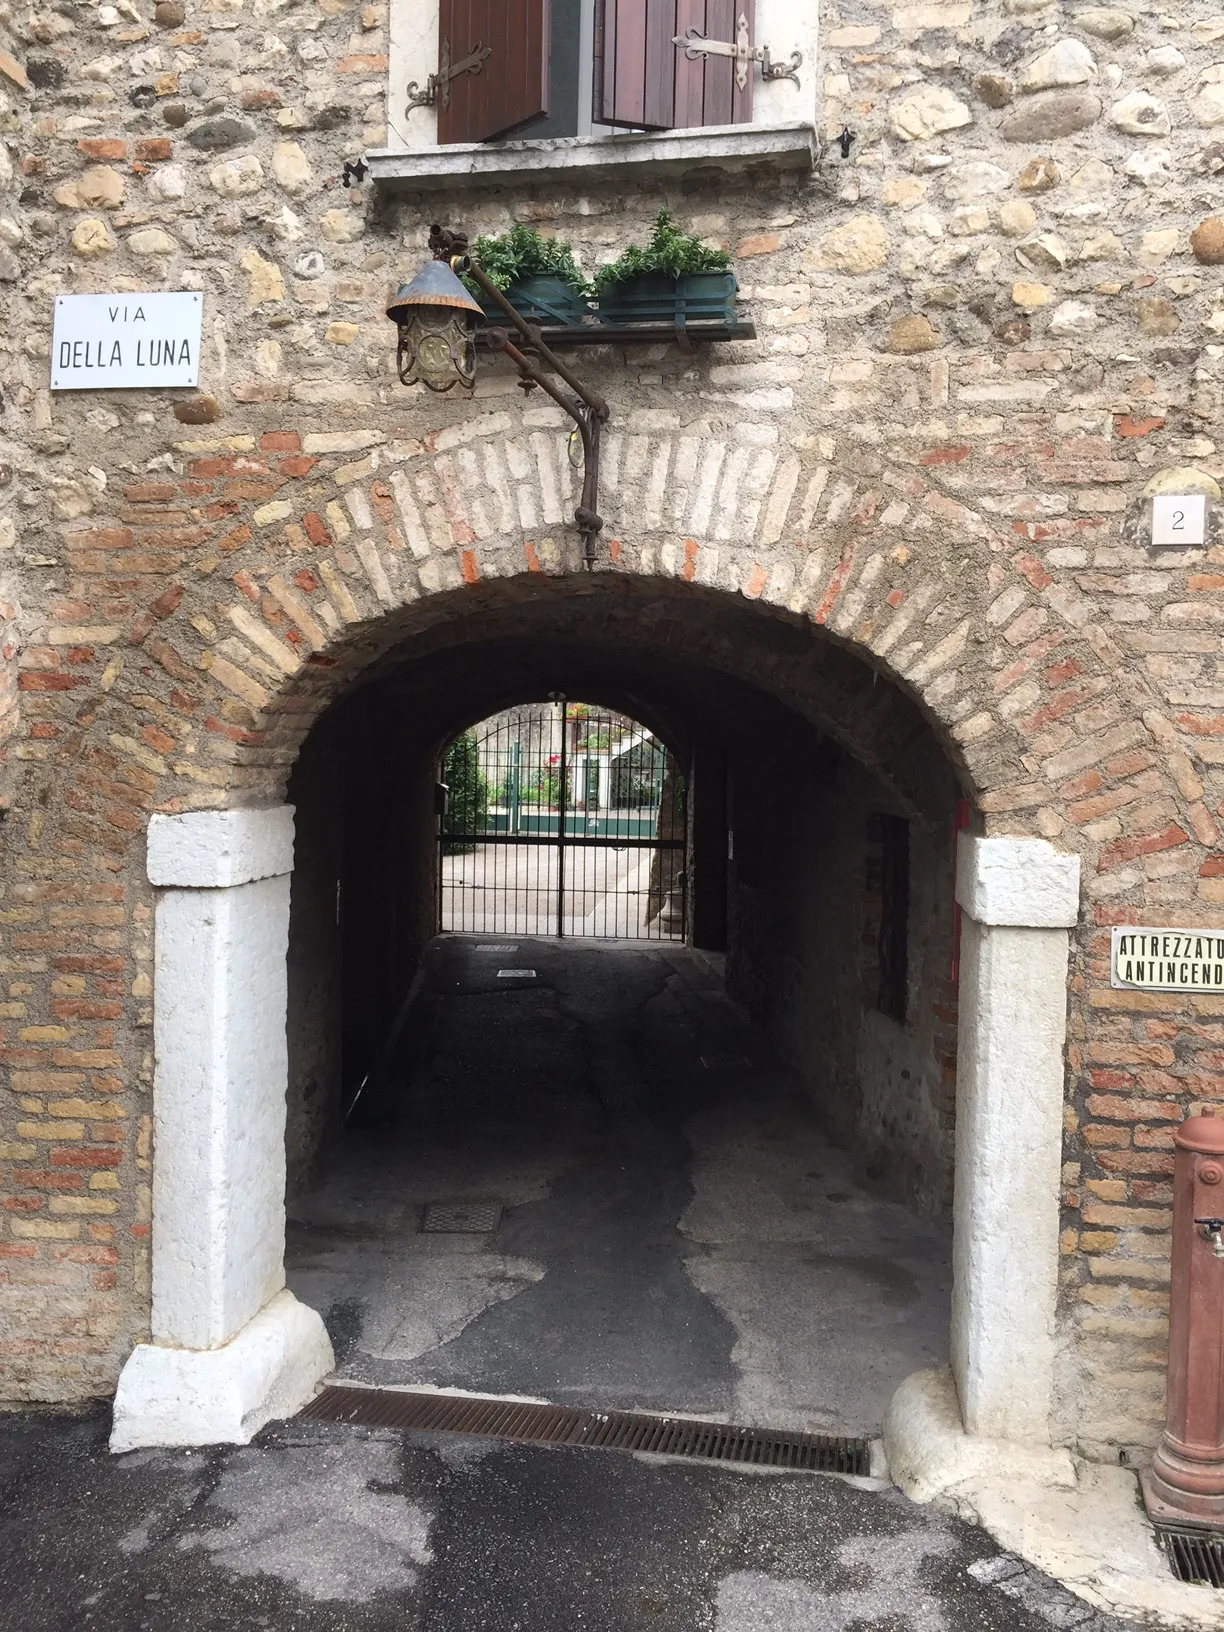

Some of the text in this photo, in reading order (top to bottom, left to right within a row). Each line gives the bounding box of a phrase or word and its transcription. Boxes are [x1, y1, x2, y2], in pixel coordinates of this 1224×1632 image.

[108, 306, 146, 323] VIA
[59, 339, 191, 369] DELLA LUNA
[1172, 510, 1185, 530] 2
[1119, 935, 1224, 960] ATTREZZATU
[1125, 960, 1223, 985] ANTINCEND
